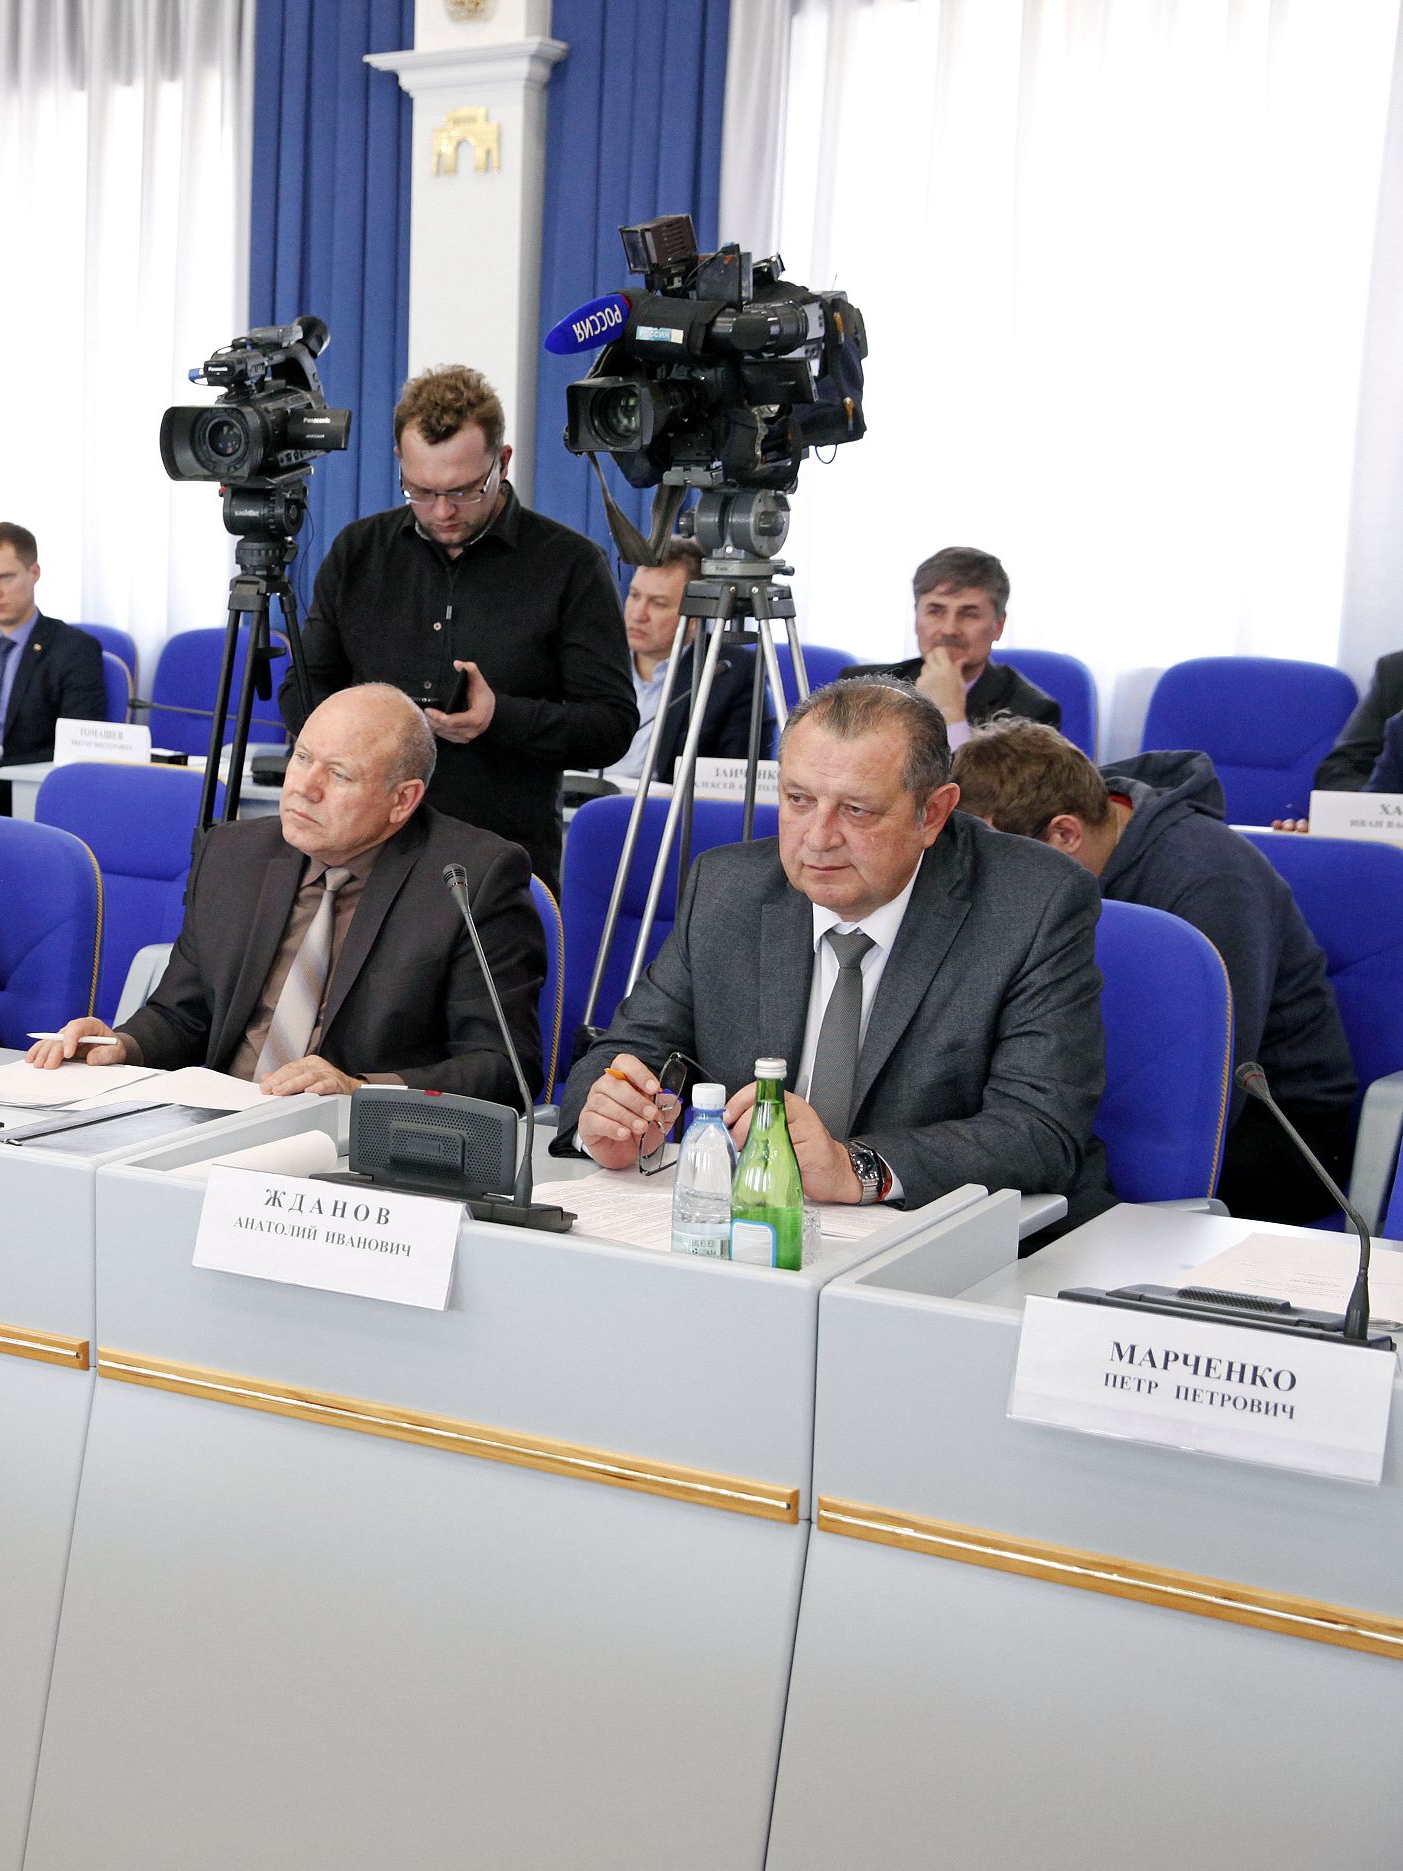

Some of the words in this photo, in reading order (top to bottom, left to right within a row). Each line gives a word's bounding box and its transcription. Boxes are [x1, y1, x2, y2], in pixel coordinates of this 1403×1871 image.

[572, 304, 622, 343] РОССИЯ
[264, 1188, 391, 1225] ЖДАНОВ
[233, 1216, 318, 1241] АНАТОЛИЙ
[325, 1231, 412, 1257] ИВАНОВИЧ
[1109, 1341, 1297, 1392] МАРЧЕНКО
[1103, 1372, 1159, 1395] ПЕТР
[1175, 1384, 1296, 1420] ПЕТРОВИЧ
